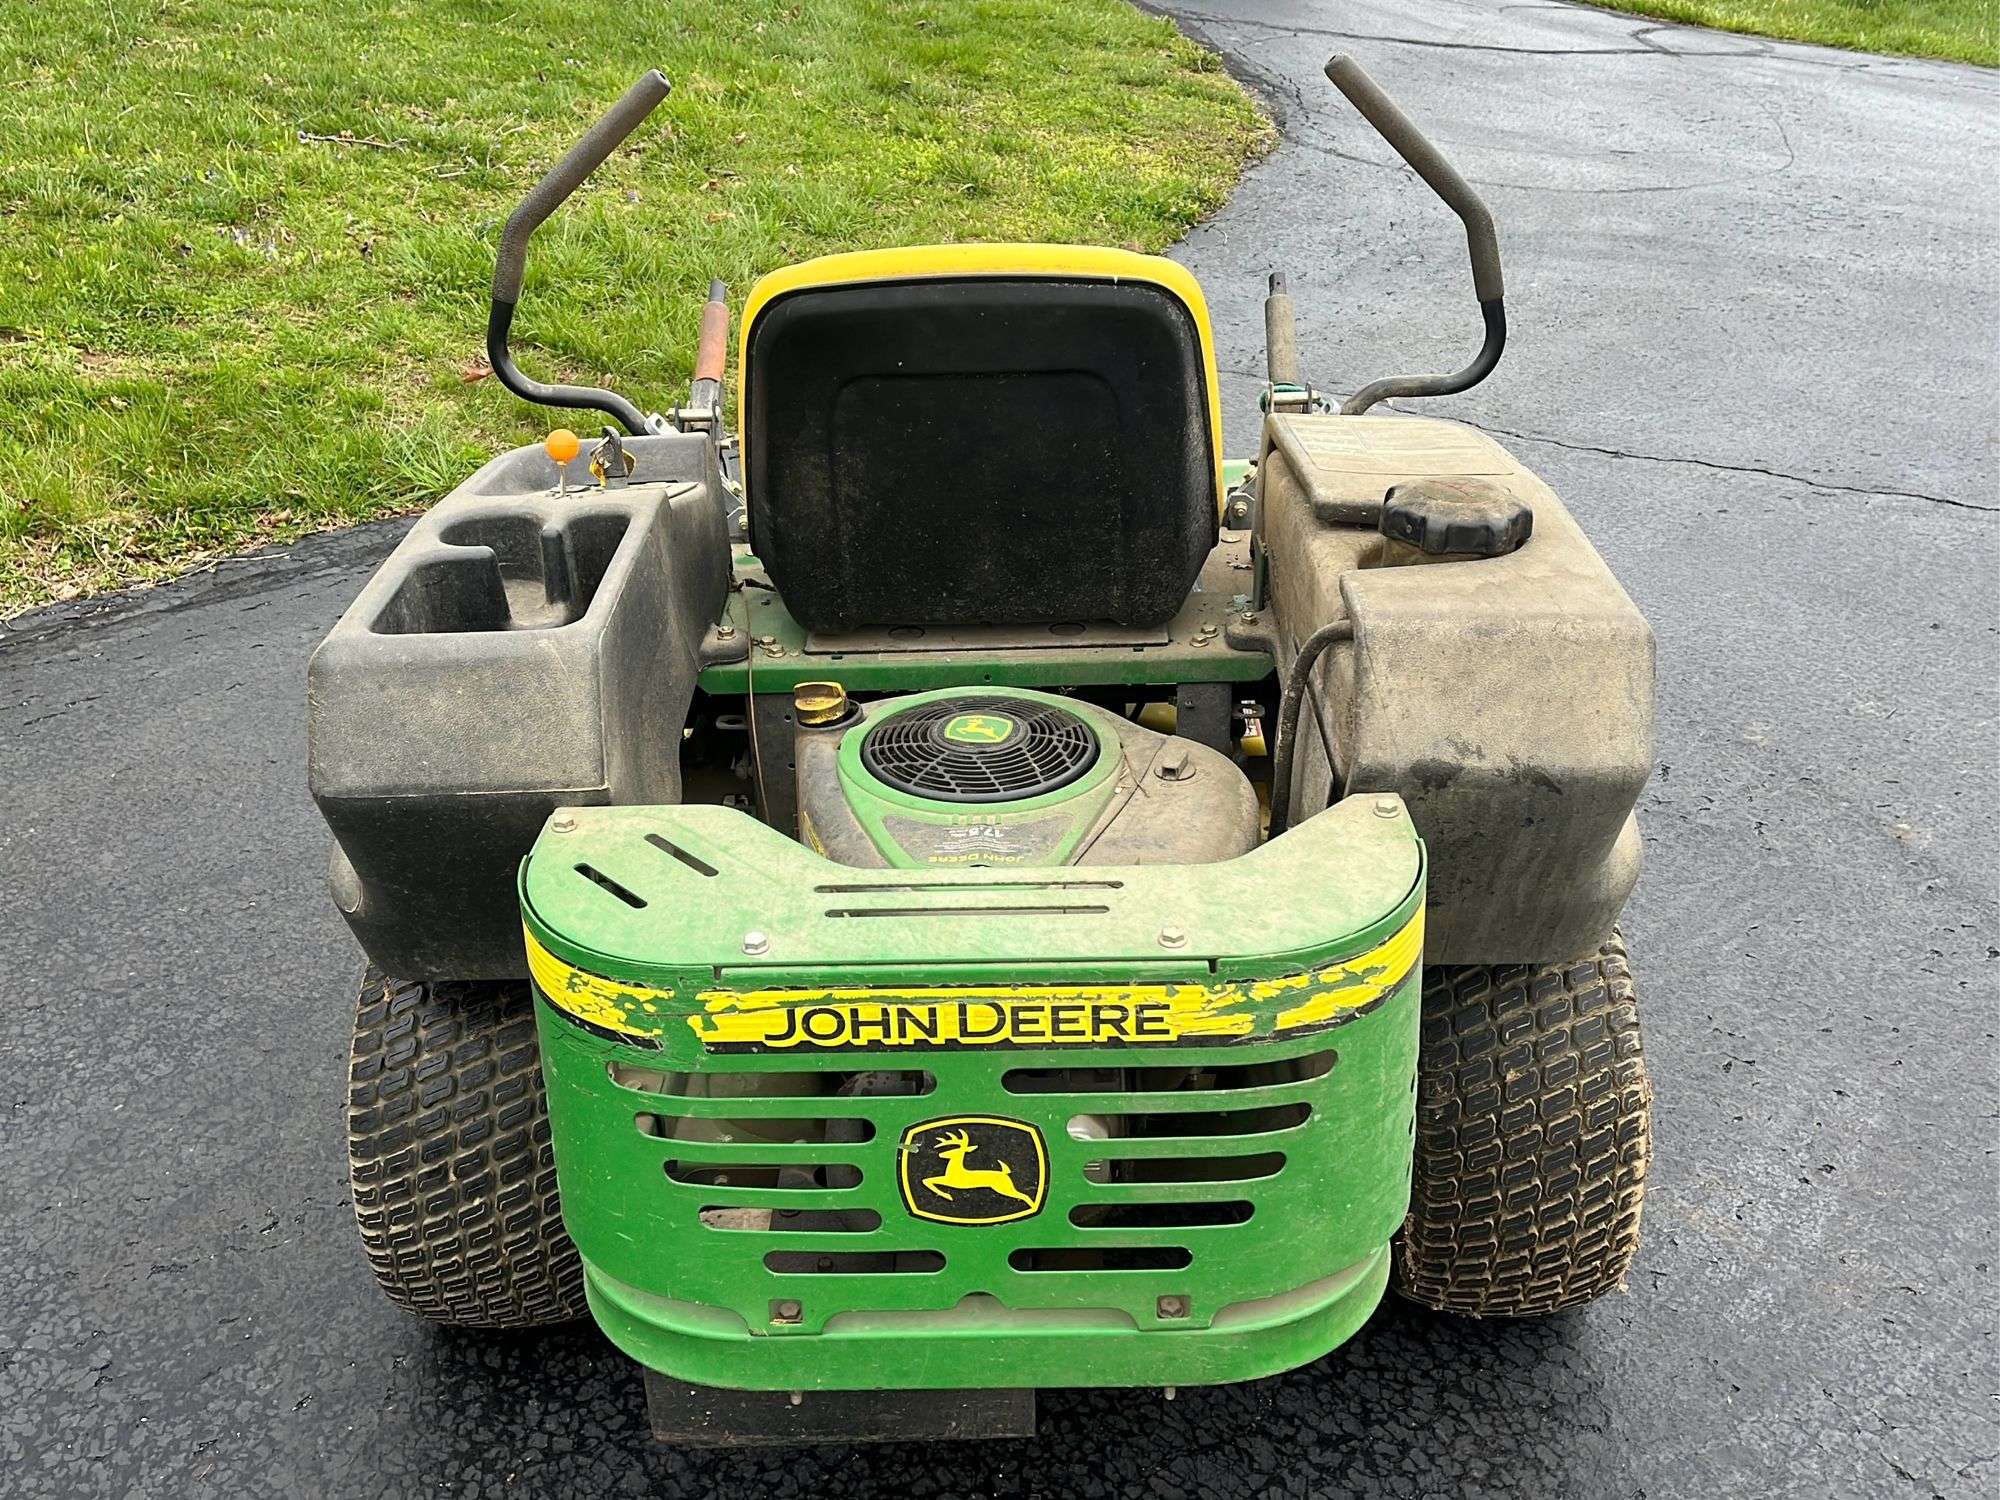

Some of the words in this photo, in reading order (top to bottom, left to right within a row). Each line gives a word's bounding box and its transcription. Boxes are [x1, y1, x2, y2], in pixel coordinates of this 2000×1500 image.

[928, 854, 980, 863] DEERE
[984, 854, 1025, 863] JOHN
[764, 1006, 938, 1041] JOHN
[958, 1002, 1171, 1038] DEERE
